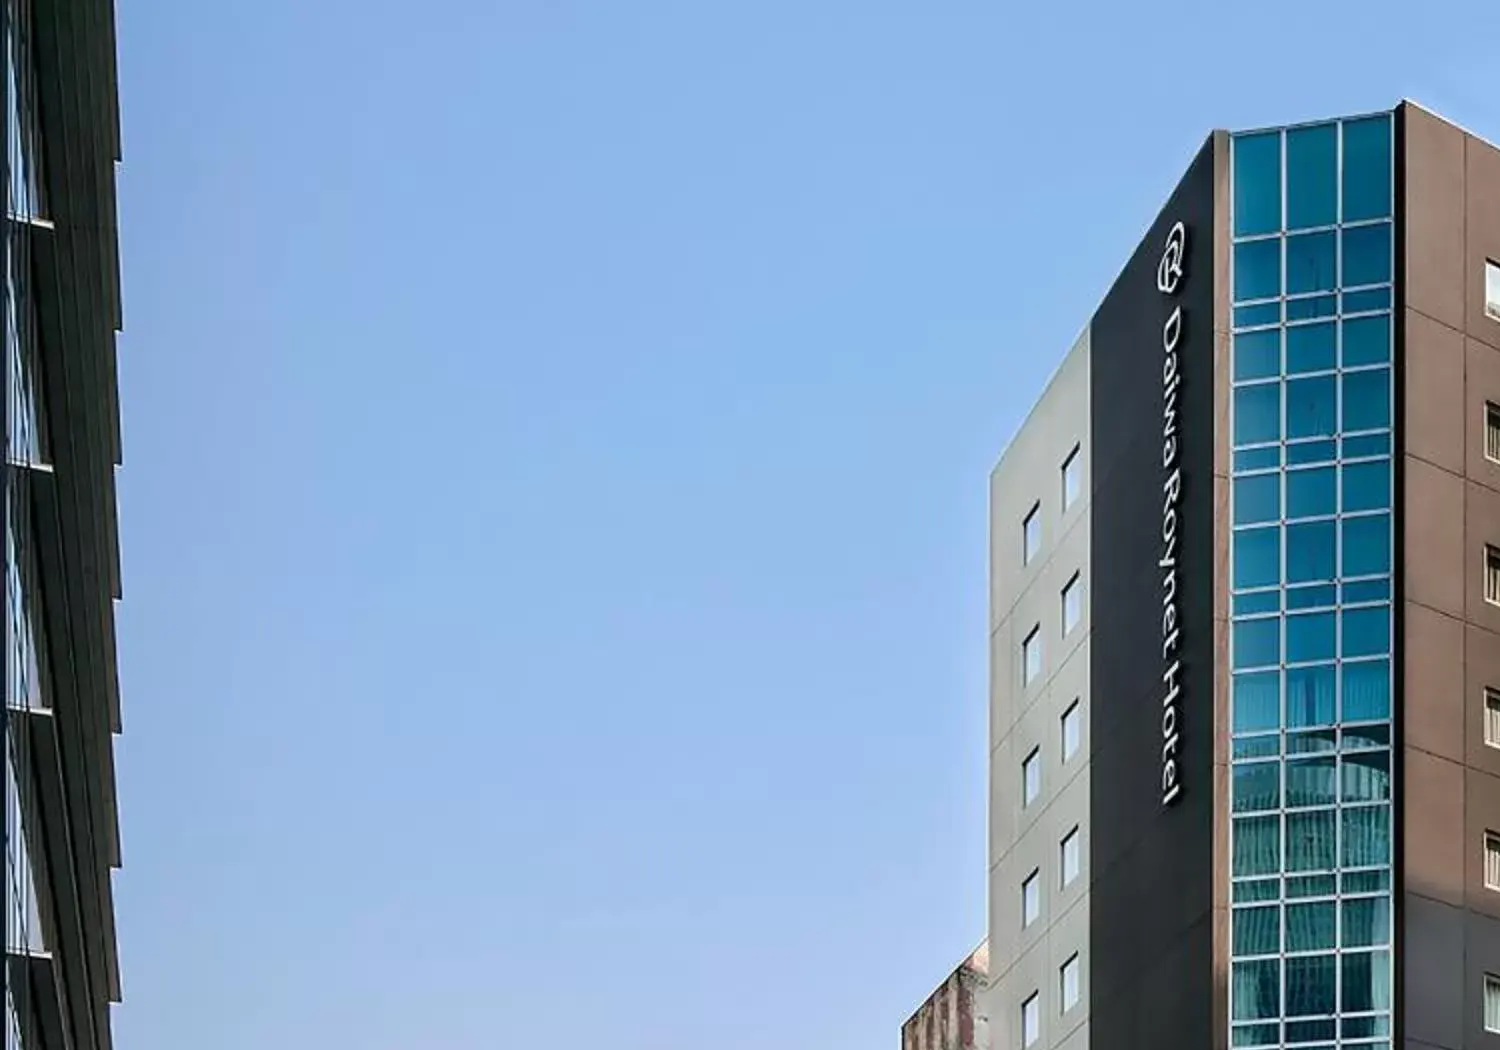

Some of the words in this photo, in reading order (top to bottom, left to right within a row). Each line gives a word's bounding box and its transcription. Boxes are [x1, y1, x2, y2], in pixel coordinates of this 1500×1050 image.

[1164, 305, 1181, 468] Daiwa
[1159, 468, 1181, 659] Roynet
[1162, 660, 1180, 805] Hotel
